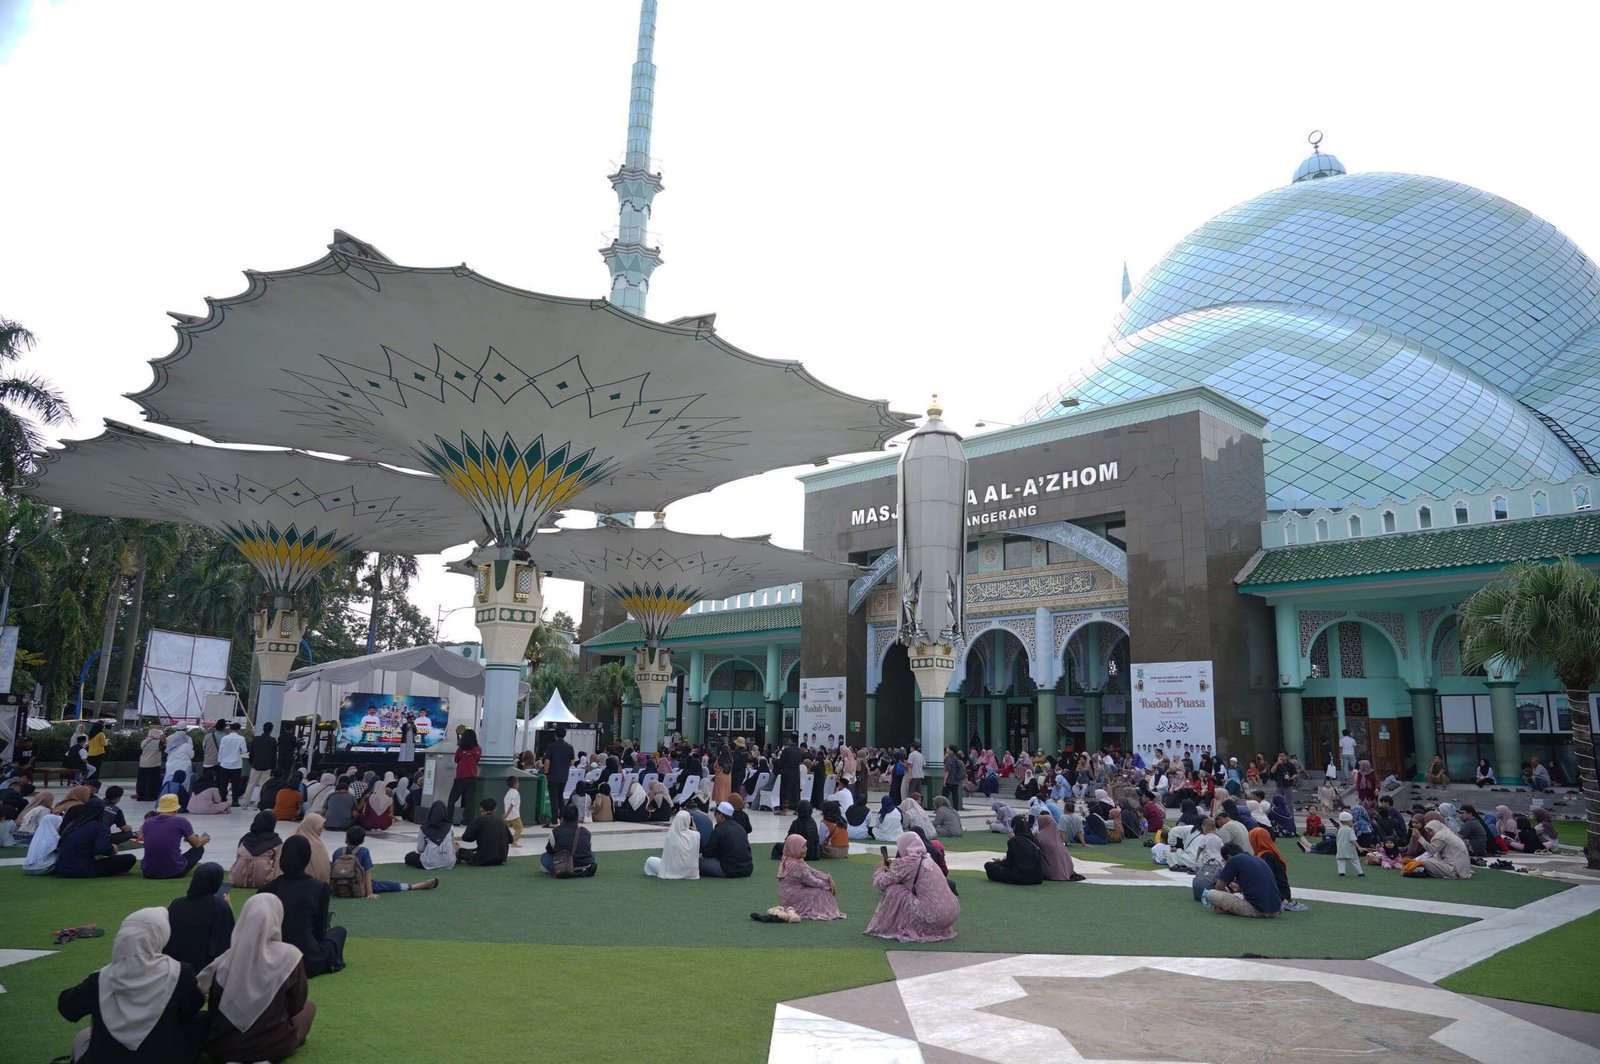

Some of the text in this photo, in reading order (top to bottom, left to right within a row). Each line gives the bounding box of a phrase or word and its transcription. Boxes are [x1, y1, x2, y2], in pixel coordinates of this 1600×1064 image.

[852, 504, 898, 525] MASJ
[984, 461, 1119, 504] AL-A'ZHOM
[1139, 696, 1206, 709] Ibadah Puasa
